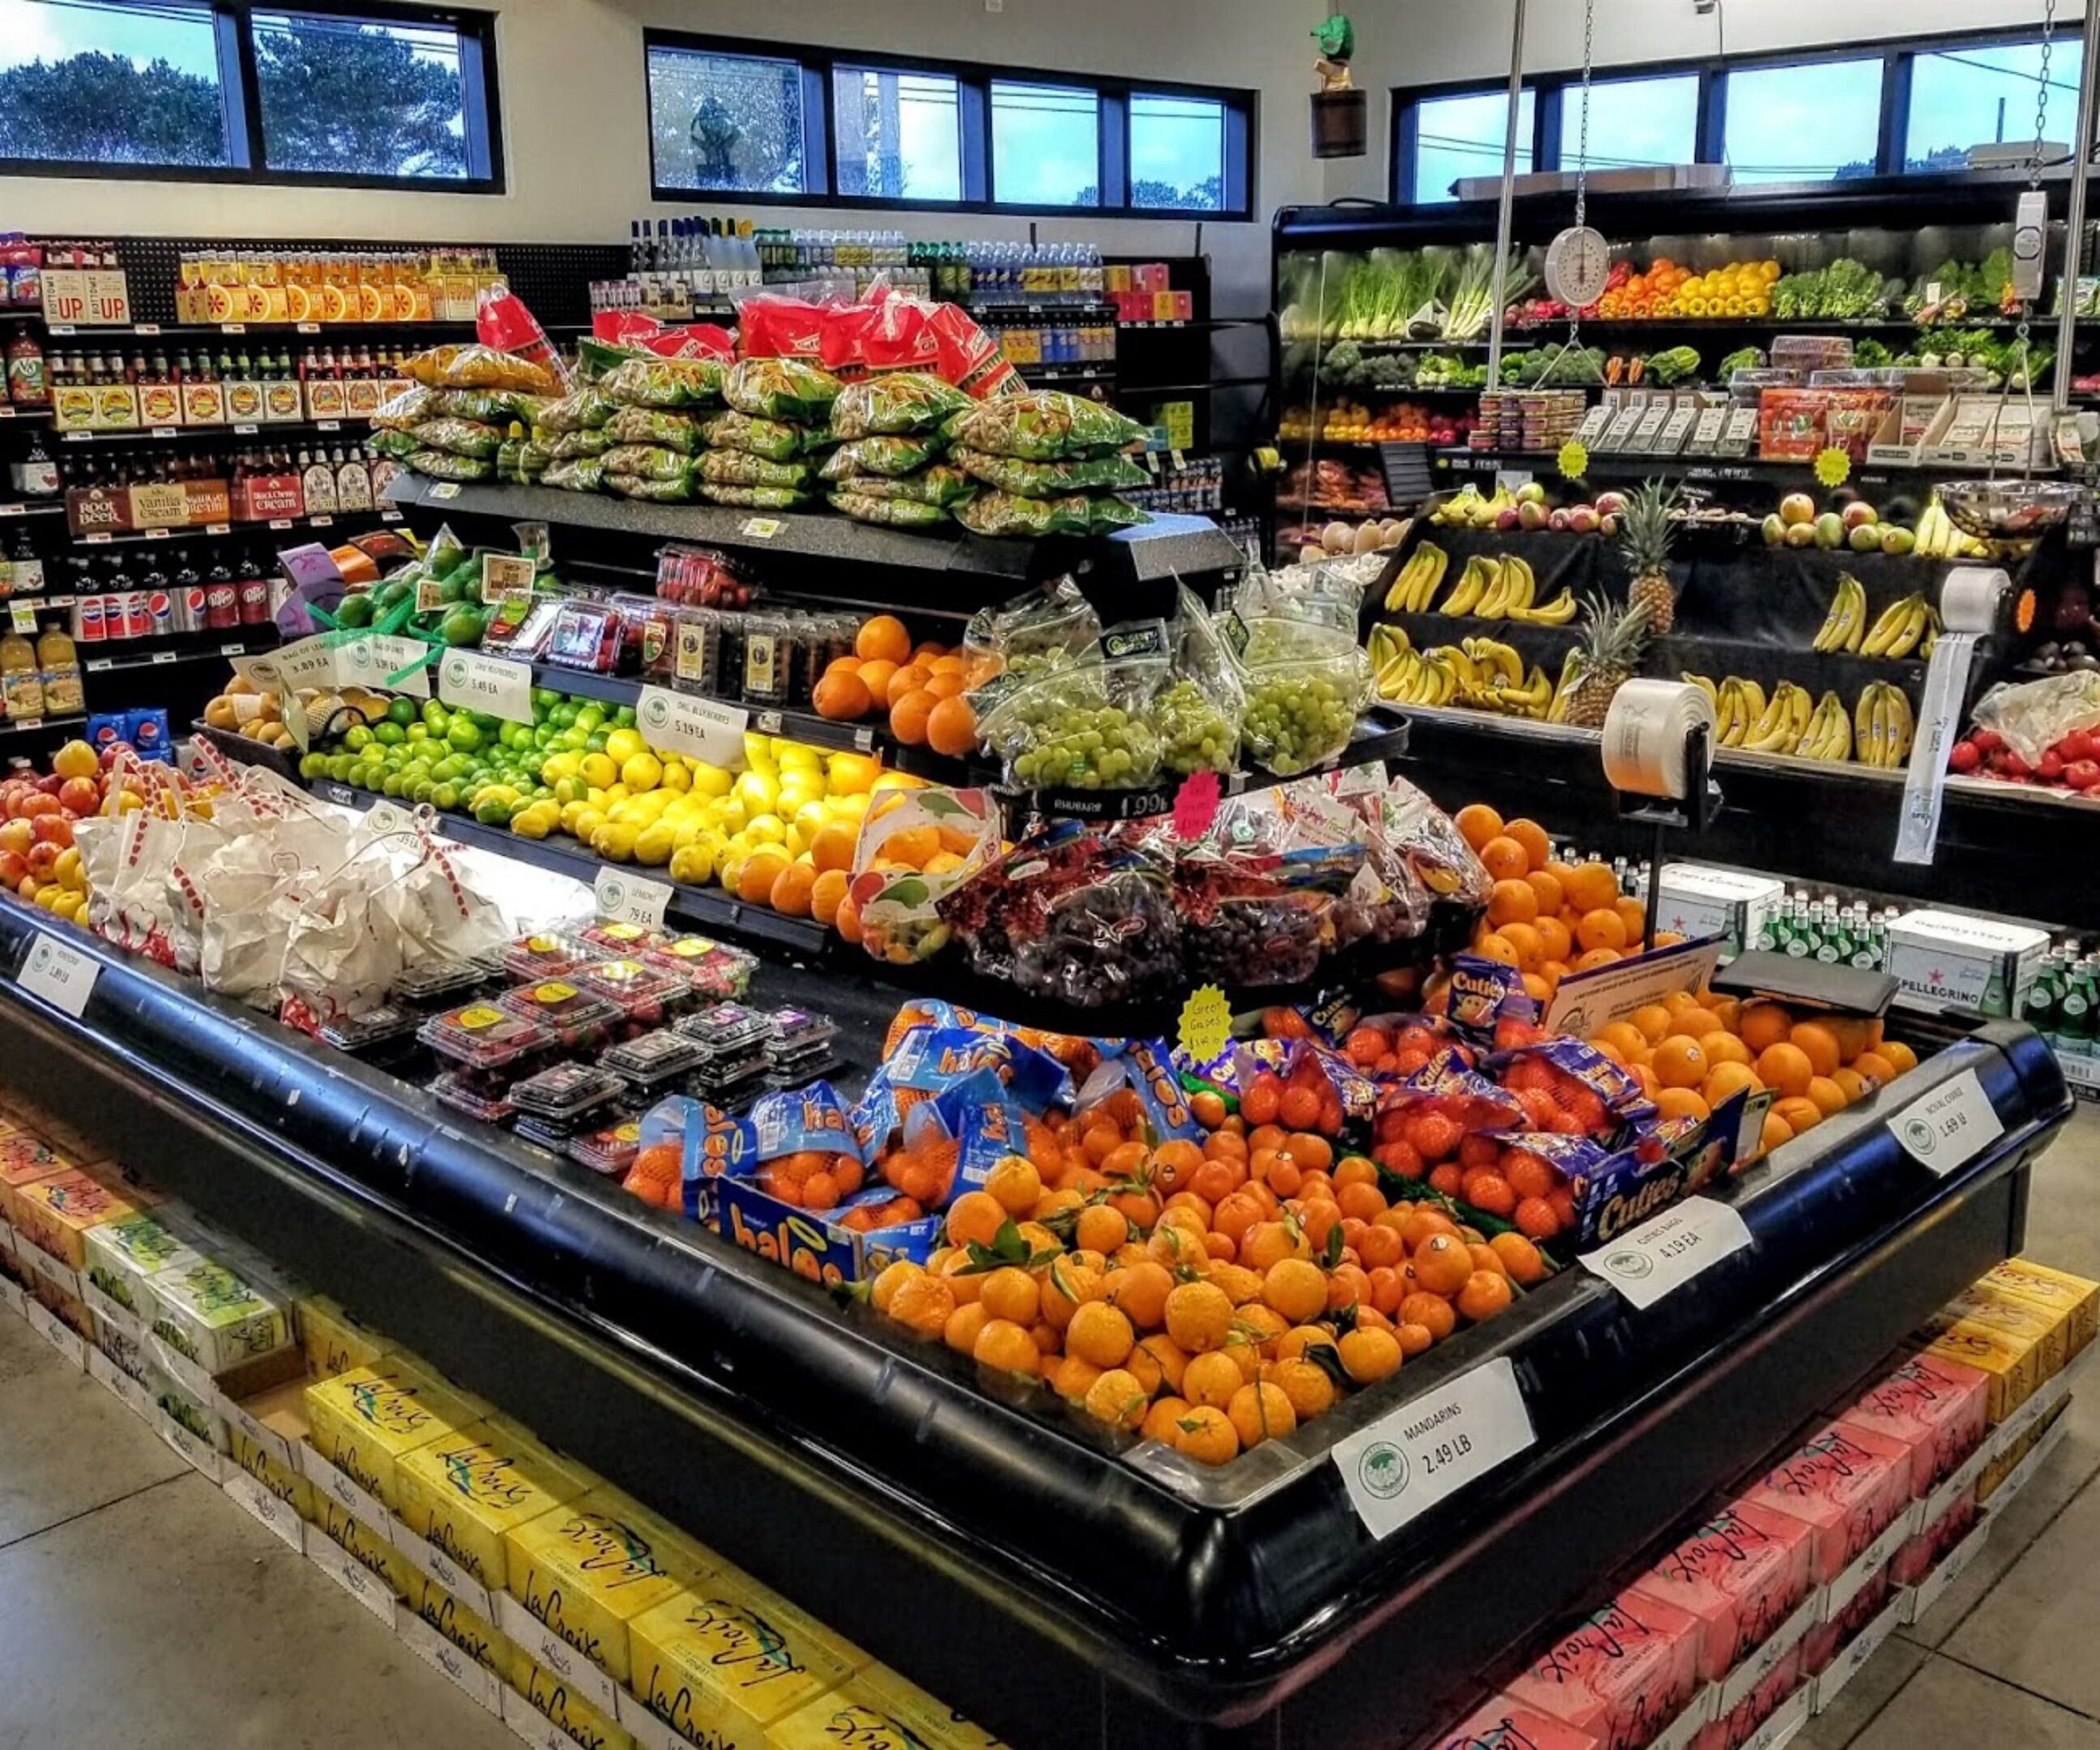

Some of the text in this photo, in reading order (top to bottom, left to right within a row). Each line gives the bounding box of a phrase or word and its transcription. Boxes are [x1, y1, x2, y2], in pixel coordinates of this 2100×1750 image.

[58, 297, 83, 319] UP
[100, 297, 125, 319] UP
[641, 911, 652, 925] EA
[1901, 979, 1979, 1005] PELLEGRINO
[1659, 1231, 1701, 1259] 4.19 EA
[1403, 1402, 1462, 1441] MANDARINS
[1422, 1433, 1473, 1475] 2.49 LB
